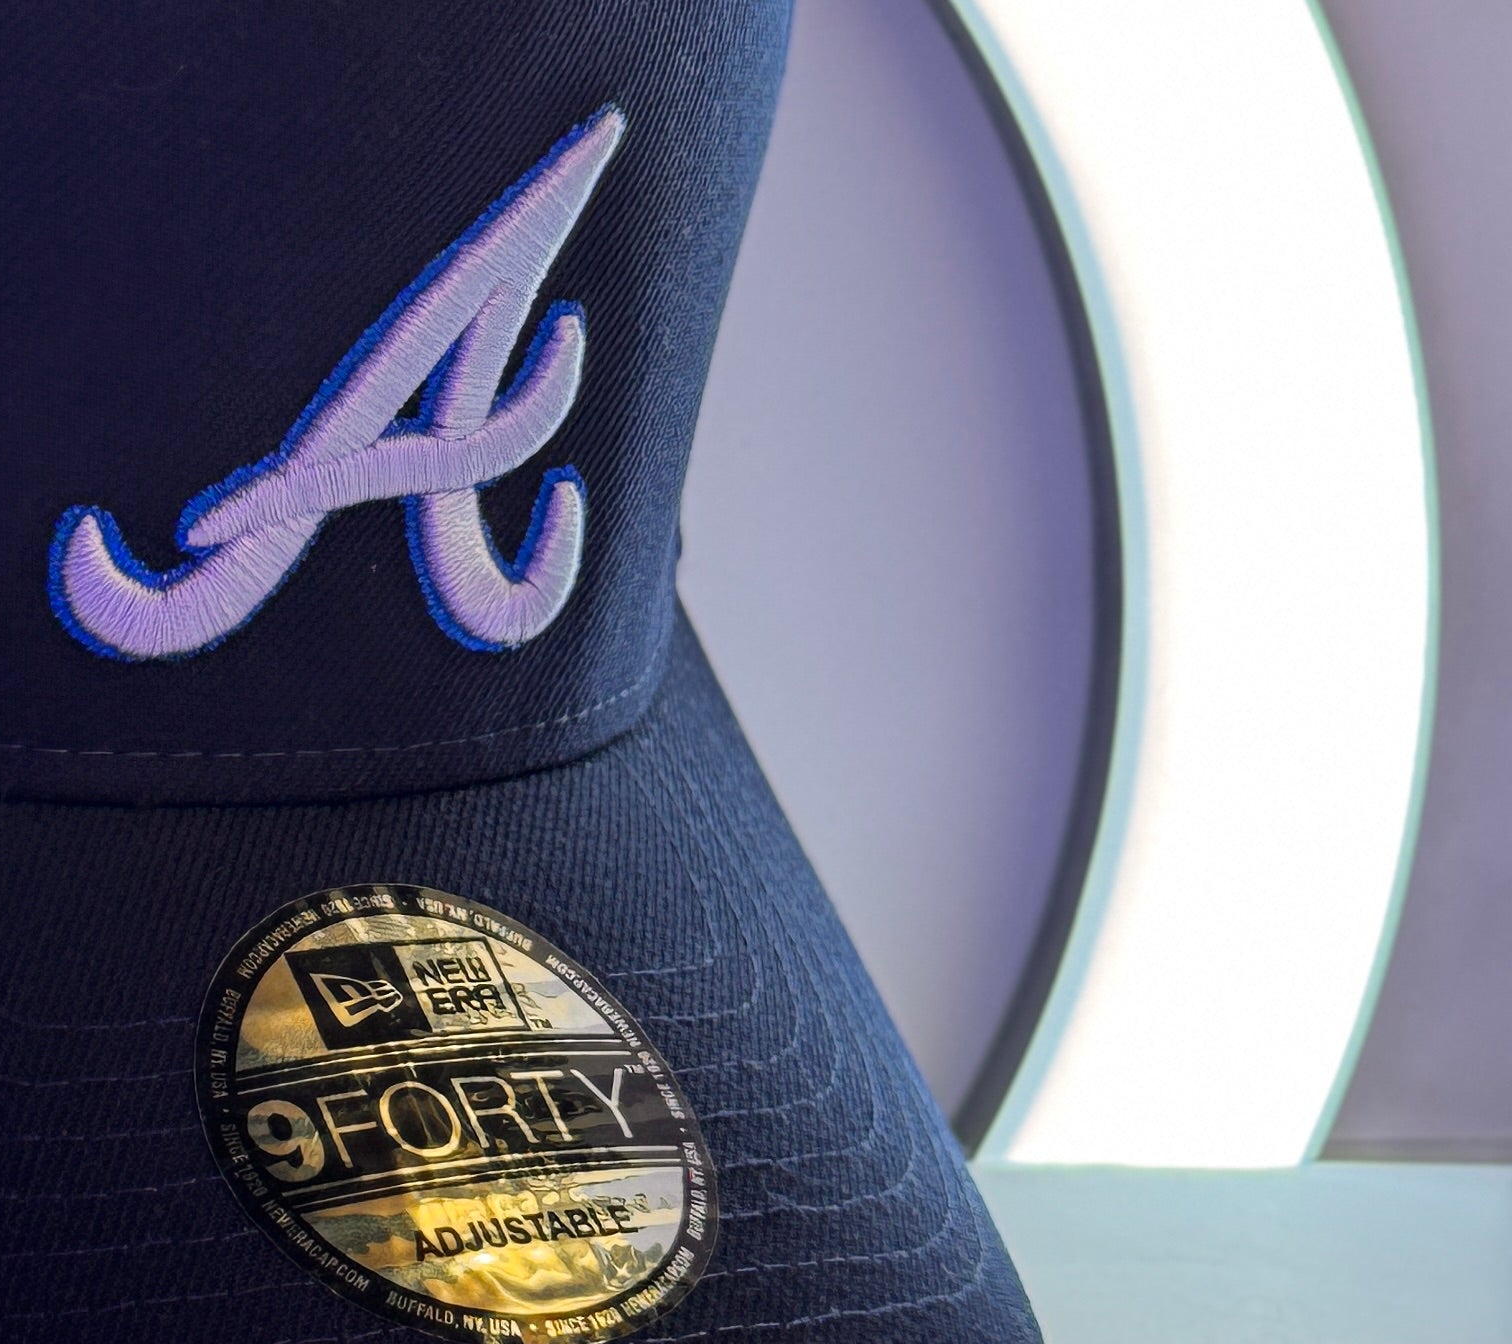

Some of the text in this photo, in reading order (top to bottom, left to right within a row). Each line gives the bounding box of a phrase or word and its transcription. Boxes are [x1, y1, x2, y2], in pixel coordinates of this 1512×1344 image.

[48, 101, 626, 660] A
[426, 982, 506, 1015] ERA
[247, 1067, 634, 1183] 9FORTY
[416, 1205, 639, 1262] ADJUSTABLE
[489, 1319, 522, 1338] USA
